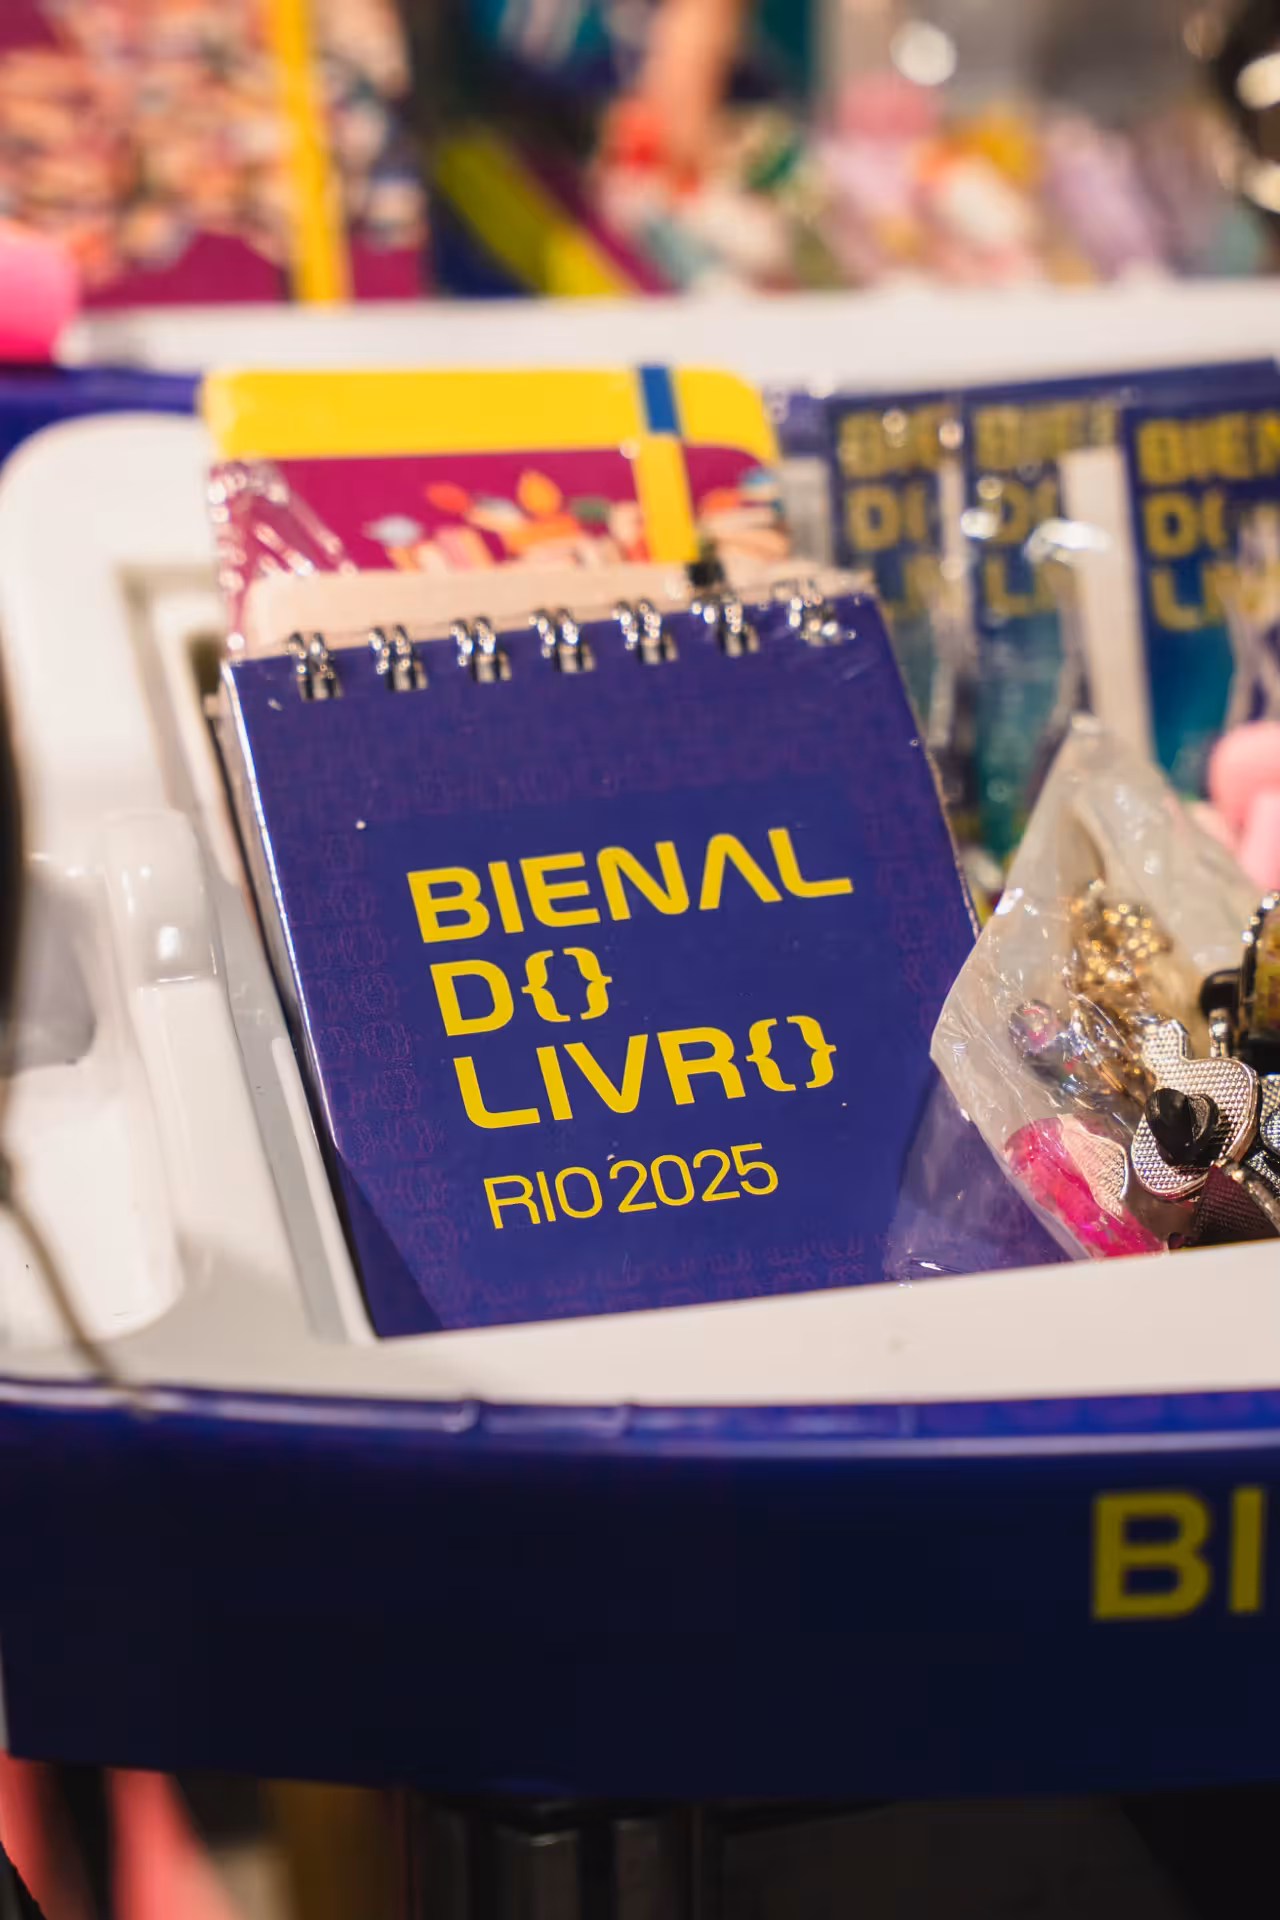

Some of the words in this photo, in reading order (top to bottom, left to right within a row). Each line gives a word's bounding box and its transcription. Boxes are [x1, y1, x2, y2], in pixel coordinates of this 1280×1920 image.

[407, 827, 854, 944] BIENAL
[483, 1165, 604, 1230] RIO
[608, 1141, 780, 1214] 2025
[1093, 1486, 1264, 1620] BI
